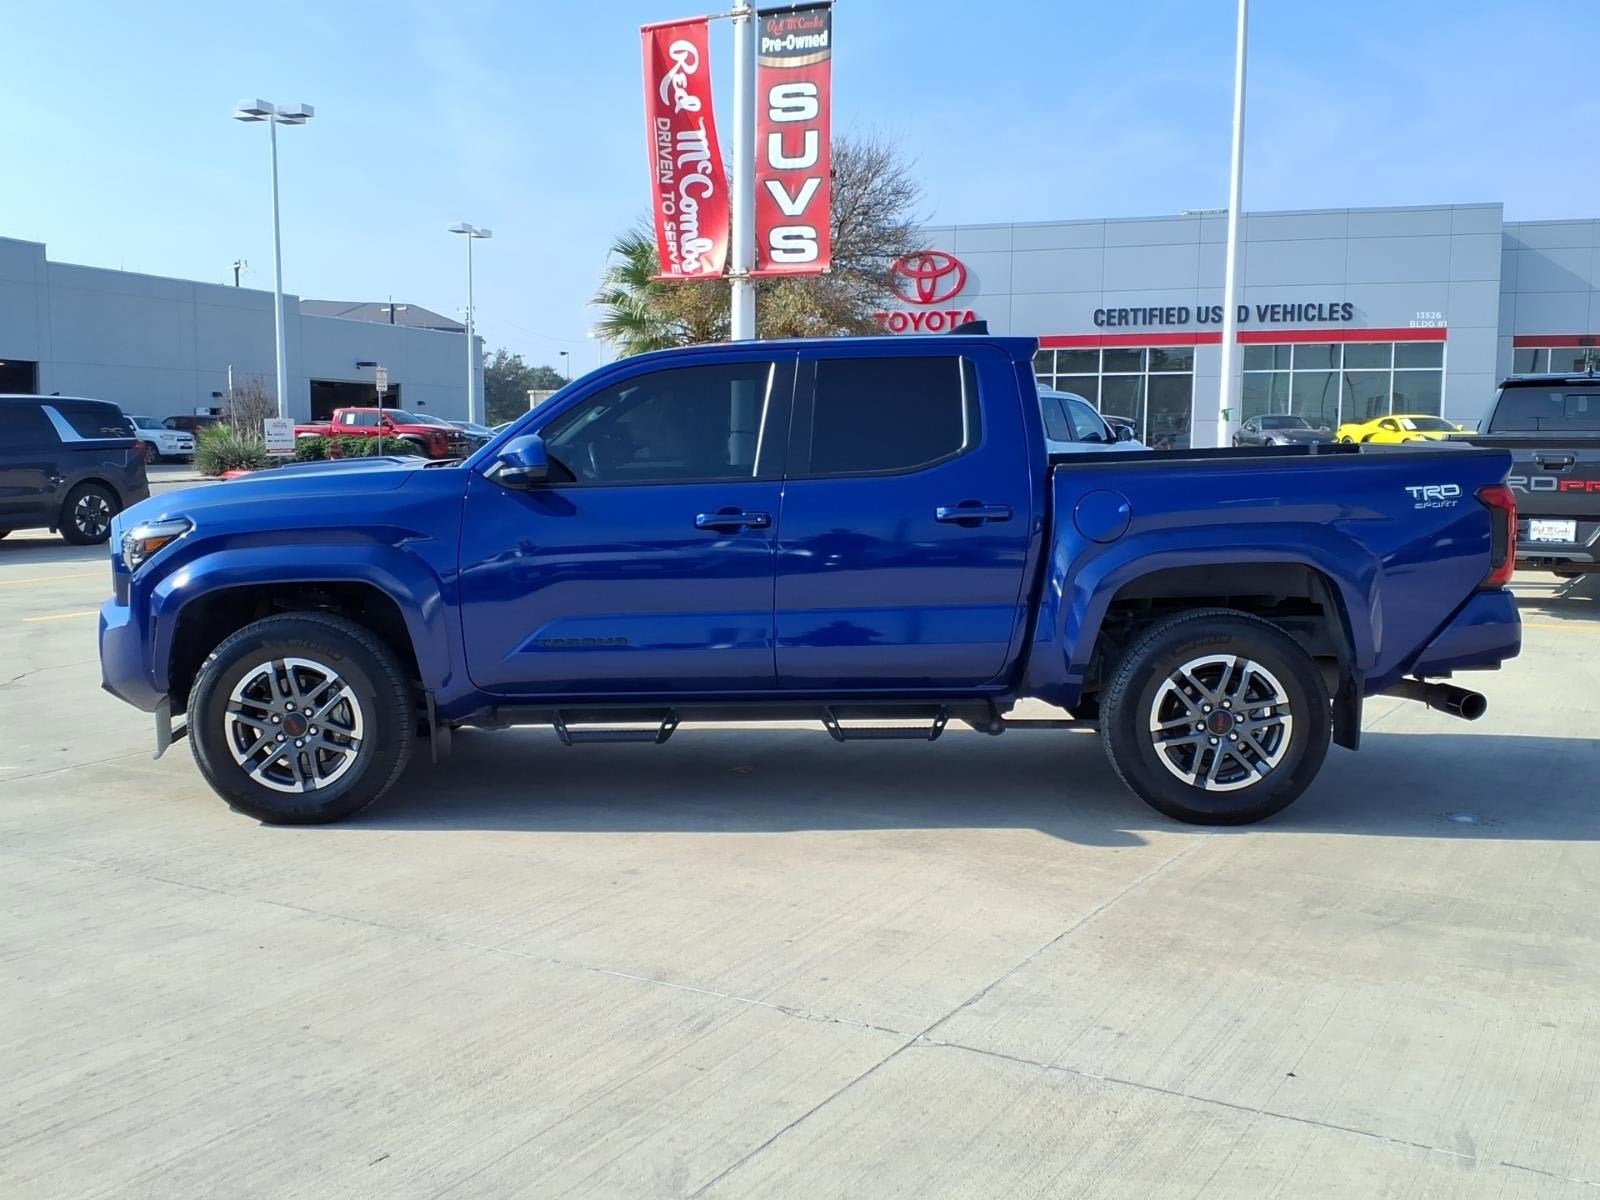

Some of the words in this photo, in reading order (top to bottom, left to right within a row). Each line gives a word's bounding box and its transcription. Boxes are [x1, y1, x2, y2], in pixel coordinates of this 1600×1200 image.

[762, 29, 828, 53] Pre-Owned
[660, 40, 701, 114] Red
[657, 117, 674, 184] DRIVEN
[662, 191, 676, 215] TO
[677, 117, 714, 272] McCombs
[663, 221, 682, 274] SERVE
[872, 310, 977, 333] TOYOTA
[1093, 307, 1190, 327] CERTIFIED
[1196, 305, 1250, 324] USD
[1256, 303, 1354, 322] VEHICLES
[1409, 320, 1435, 328] BLDG
[1416, 311, 1442, 319] 13526
[1405, 484, 1460, 500] TRD
[1506, 476, 1557, 493] RD
[1413, 500, 1459, 509] SPORT
